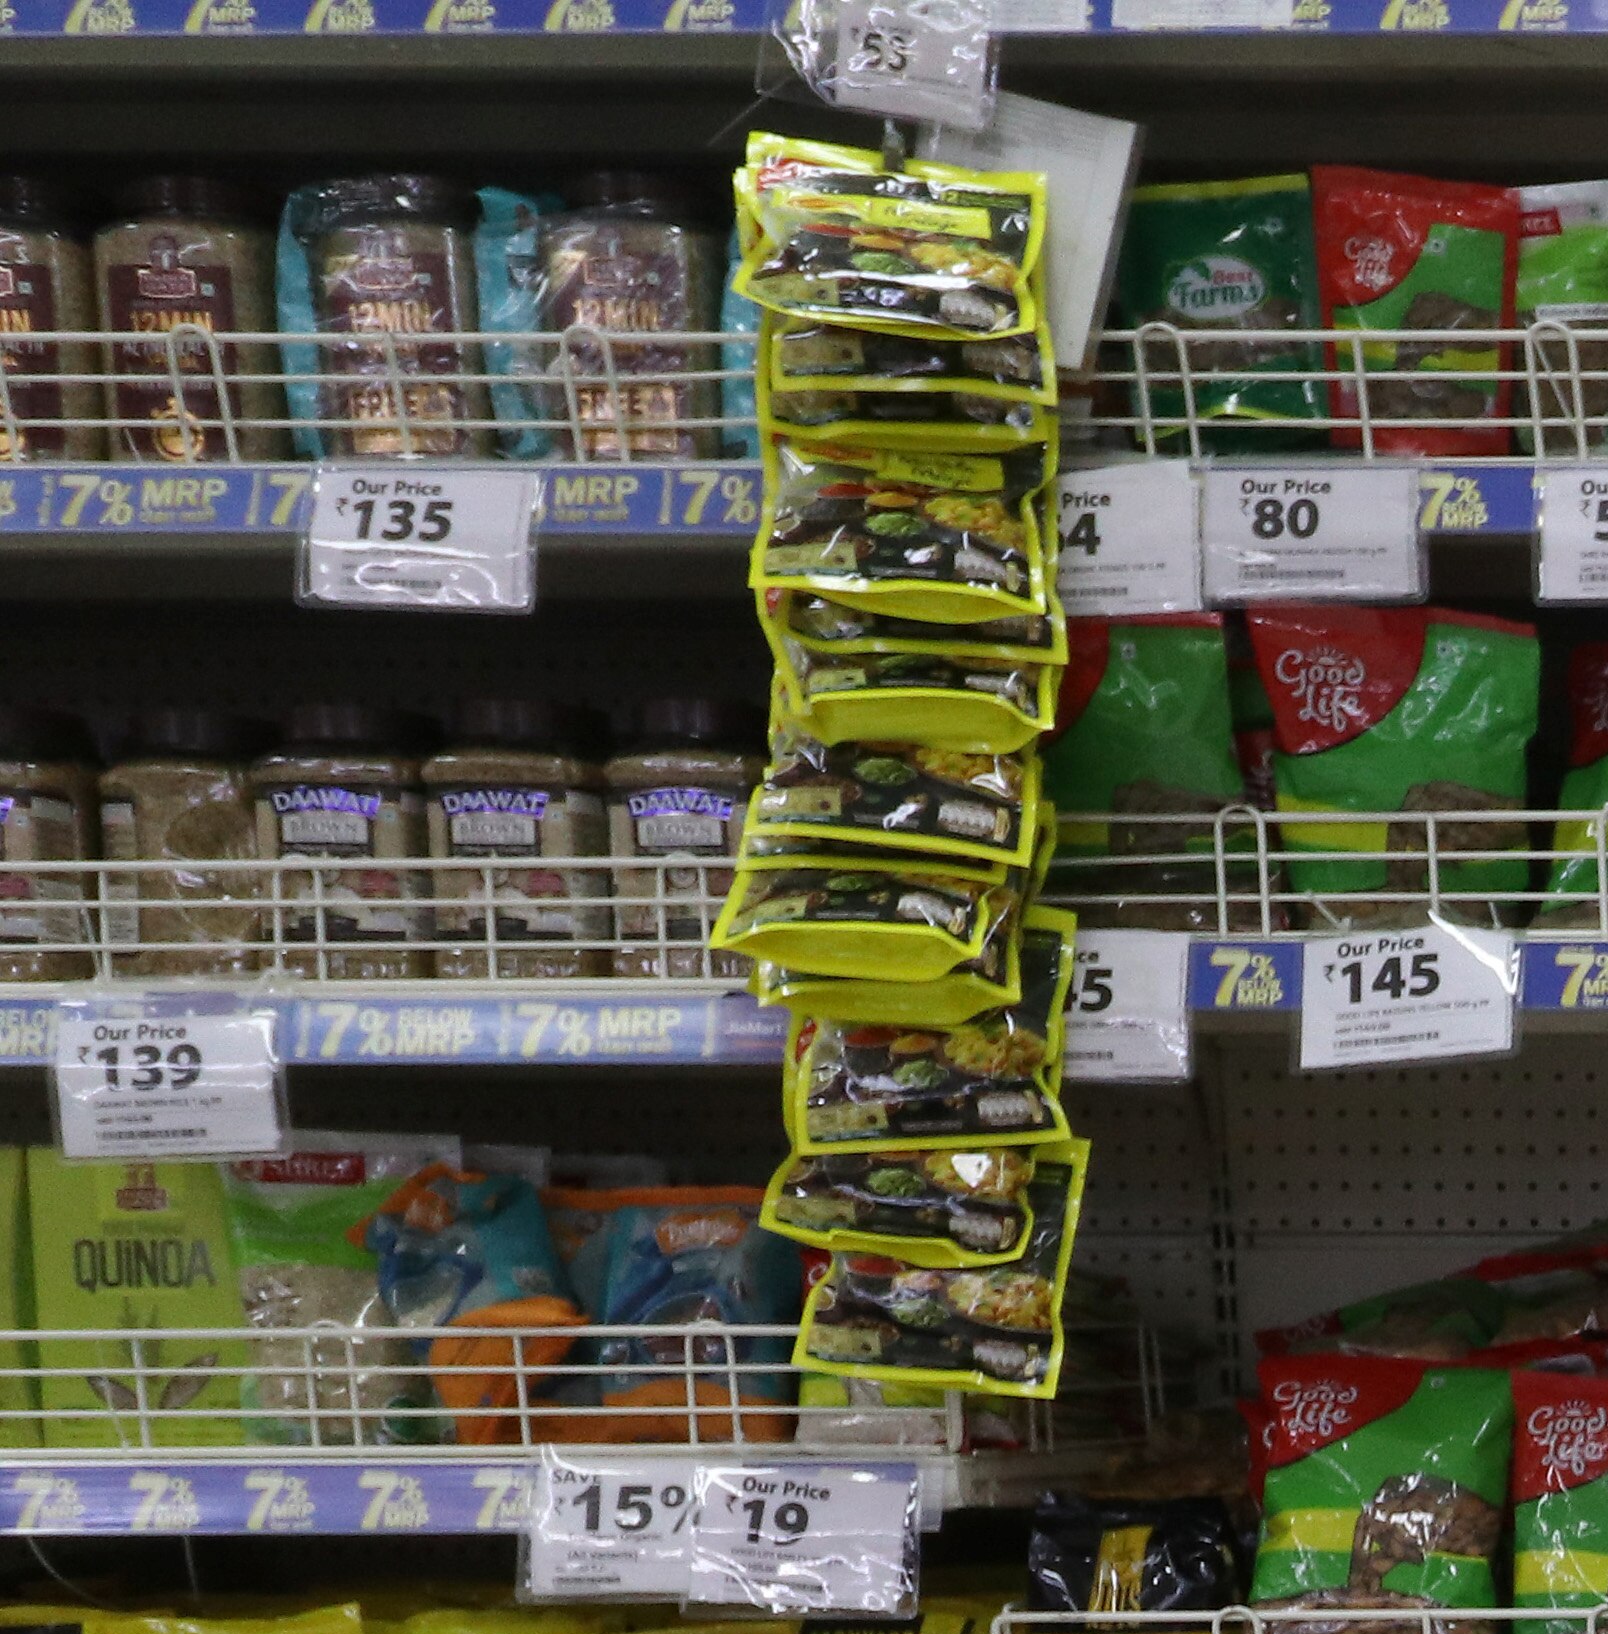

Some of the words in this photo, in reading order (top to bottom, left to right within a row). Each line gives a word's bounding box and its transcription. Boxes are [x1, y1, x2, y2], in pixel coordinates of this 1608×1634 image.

[352, 479, 389, 497] Our
[394, 479, 443, 498] Price
[1241, 479, 1277, 494] Our
[1284, 479, 1332, 494] Price
[1062, 493, 1111, 508] Price
[1276, 651, 1363, 690] Good
[1300, 690, 1362, 731] Life
[274, 788, 377, 817] DAAWAT
[630, 790, 731, 817] DAAWAT
[1336, 942, 1373, 960] Our
[1378, 936, 1425, 955] Price
[93, 1024, 132, 1042] Our
[137, 1024, 187, 1042] Price
[73, 1237, 217, 1291] QUINOA
[1273, 1380, 1358, 1414] Good
[1291, 1403, 1353, 1435] Life
[743, 1477, 778, 1495] Our
[784, 1481, 831, 1501] Price
